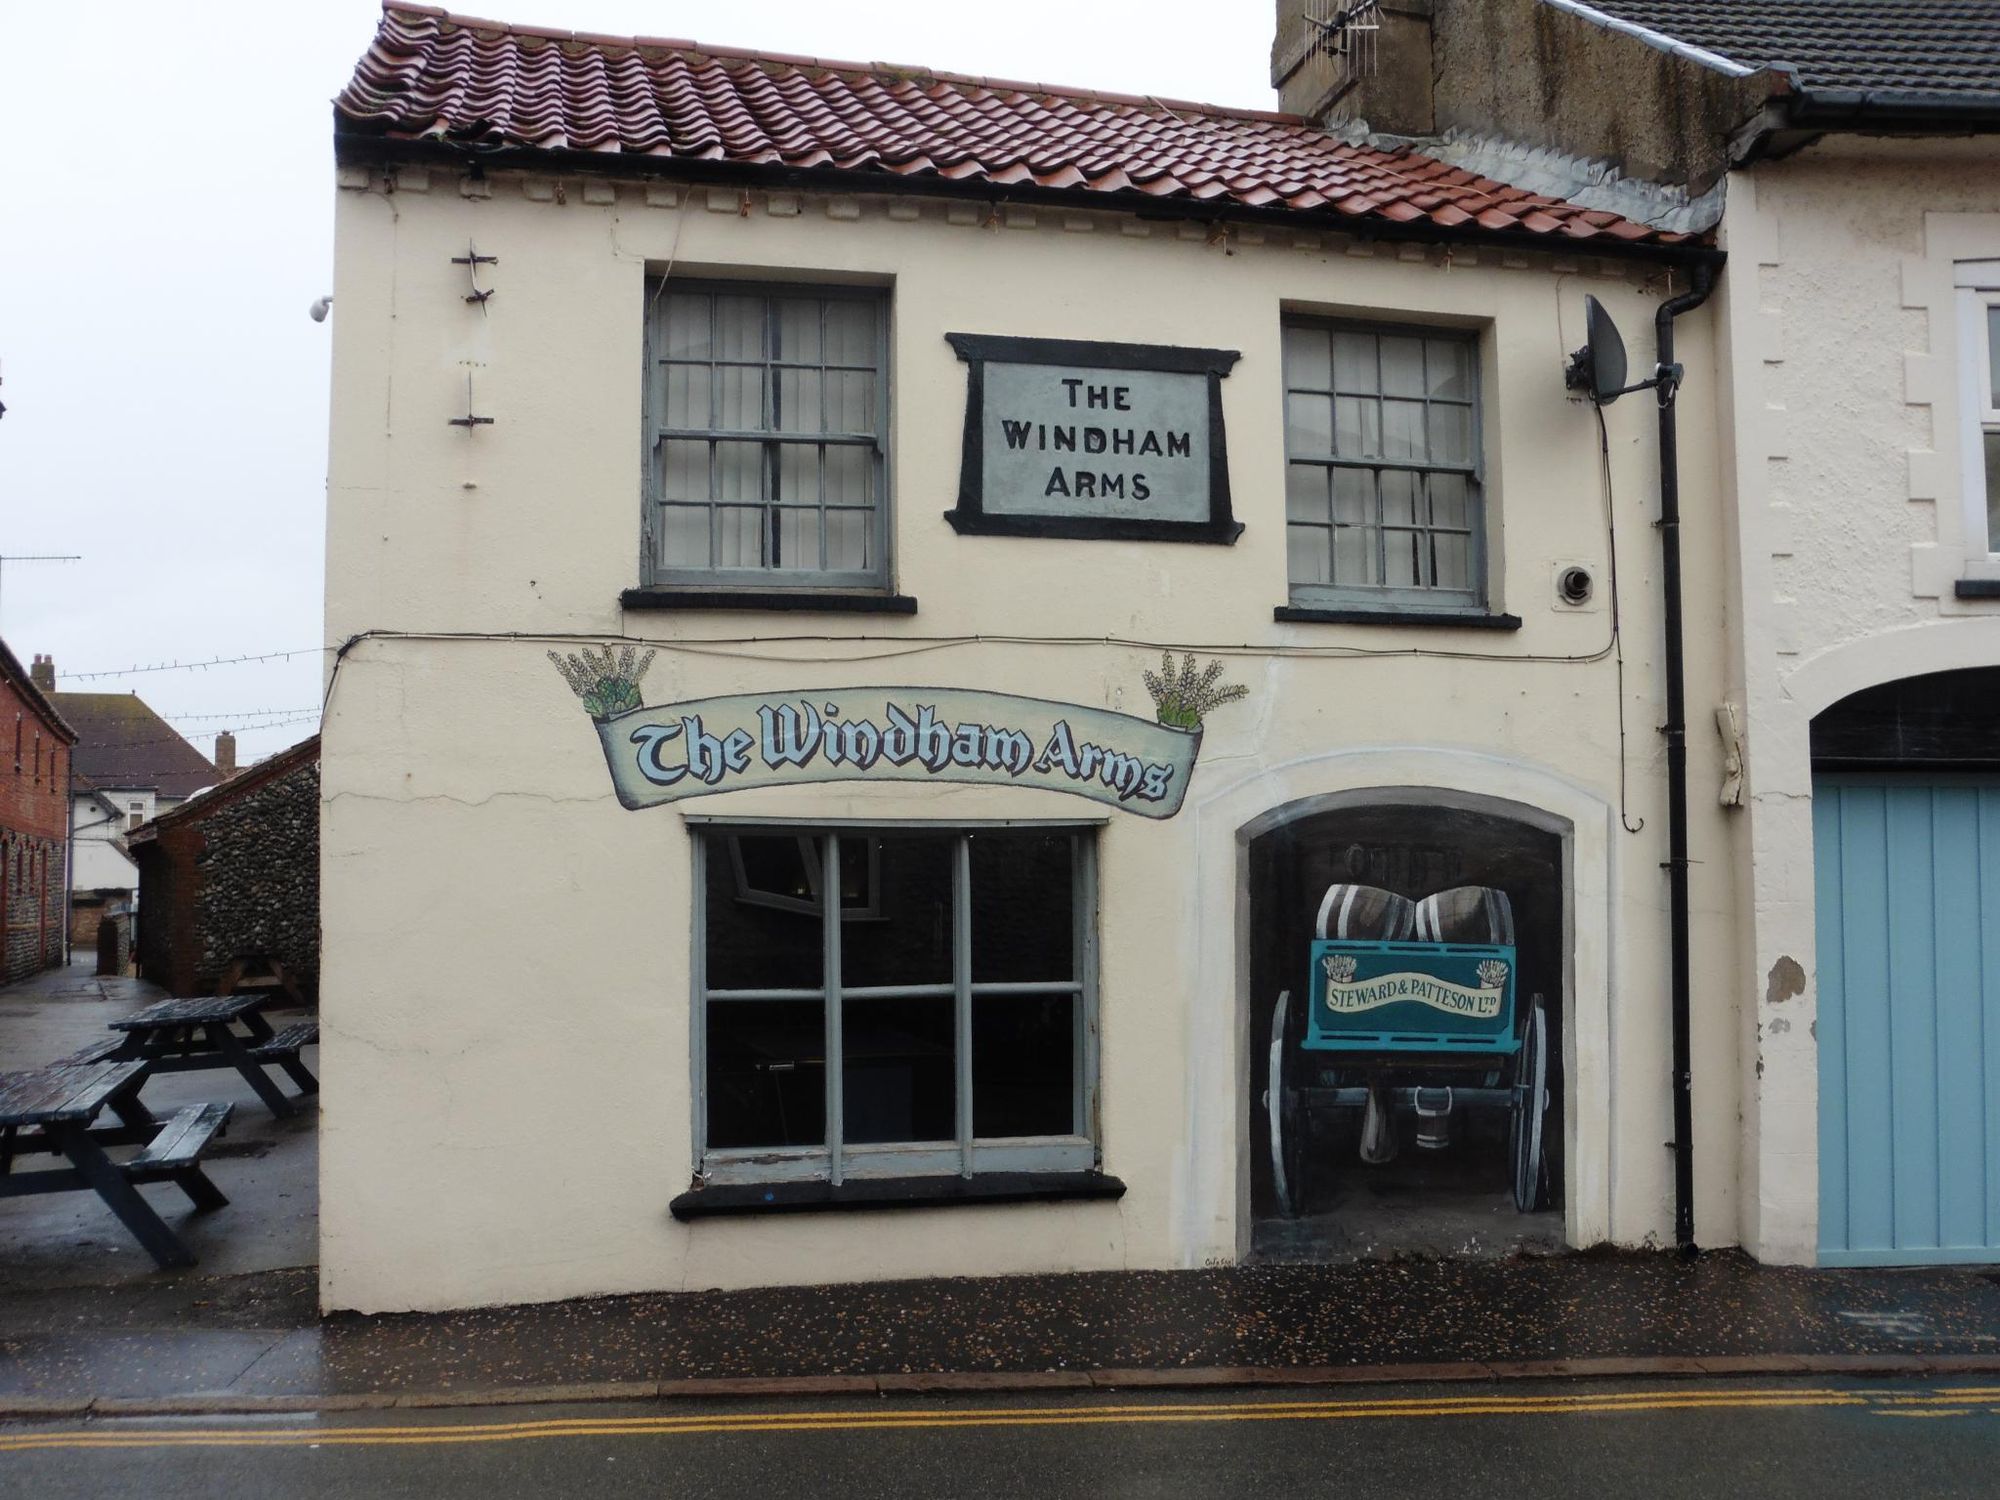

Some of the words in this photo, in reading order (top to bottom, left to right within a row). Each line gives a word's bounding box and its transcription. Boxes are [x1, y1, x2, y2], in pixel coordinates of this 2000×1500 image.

[1061, 378, 1132, 411] THE
[1002, 420, 1190, 458] WINDHAM
[1045, 466, 1150, 501] ARMS
[629, 714, 756, 786] The
[756, 699, 1035, 778] Windham
[1033, 719, 1174, 802] Arms
[1411, 978, 1474, 1011] PATTESON
